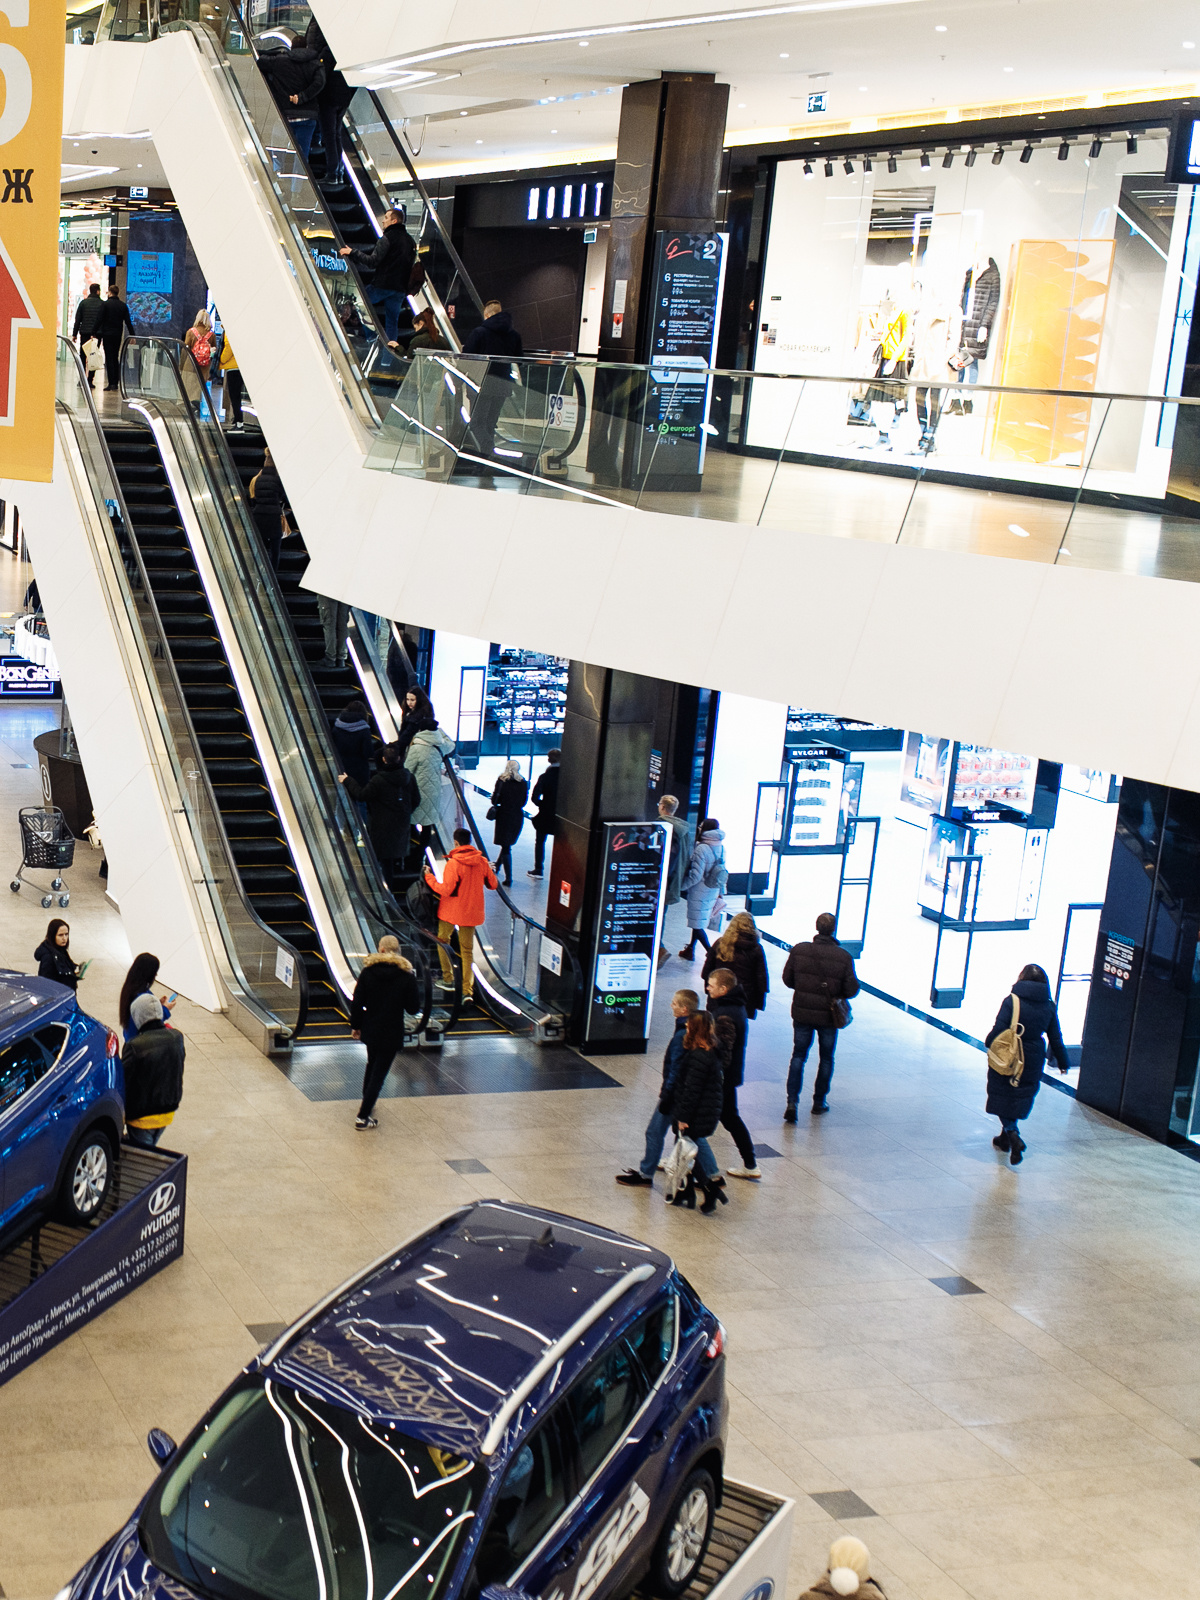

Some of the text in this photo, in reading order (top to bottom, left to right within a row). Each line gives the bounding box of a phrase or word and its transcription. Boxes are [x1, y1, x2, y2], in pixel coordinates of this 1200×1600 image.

[702, 239, 717, 260] 2
[664, 272, 671, 282] 6
[661, 297, 669, 307] 5
[659, 319, 667, 329] 4
[657, 338, 665, 348] 3
[651, 386, 659, 396] 1
[645, 423, 696, 433] -1 euroopt
[792, 749, 828, 757] BVLGARI
[647, 831, 661, 849] 1
[610, 862, 618, 871] 6
[608, 884, 616, 893] 5
[606, 903, 613, 912] 4
[604, 920, 612, 929] 3
[603, 934, 610, 943] 2
[140, 1204, 181, 1241] HYUNDAI
[10, 1318, 45, 1349] АвтоГрад»
[131, 1245, 147, 1264] +375
[147, 1241, 155, 1253] 17
[155, 1233, 167, 1248] 333
[167, 1224, 180, 1243] 5000
[10, 1341, 32, 1366] Центр
[131, 1260, 147, 1279] +375
[147, 1256, 154, 1268] 17
